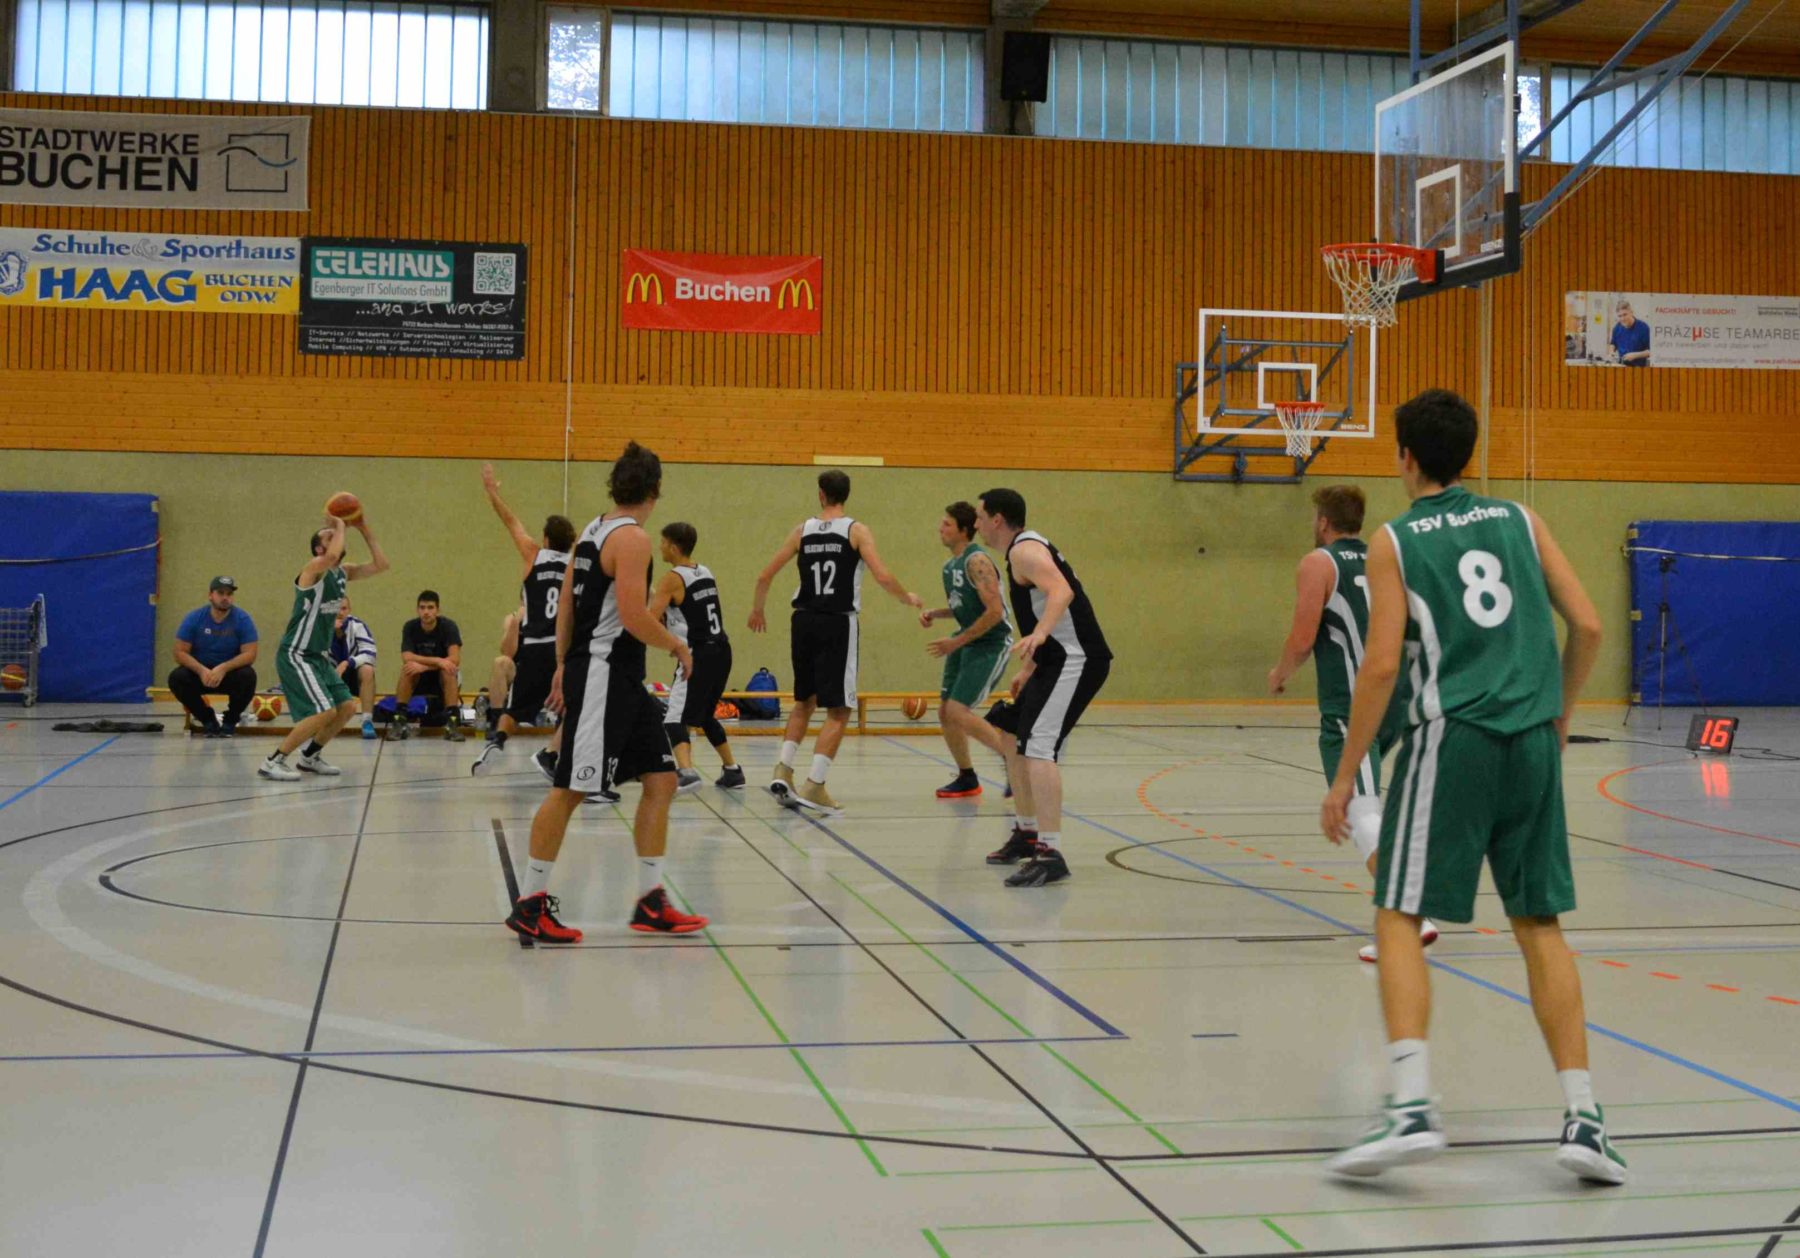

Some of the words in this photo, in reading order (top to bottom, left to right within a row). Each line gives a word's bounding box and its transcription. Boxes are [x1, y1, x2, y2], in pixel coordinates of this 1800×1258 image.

[0, 126, 200, 155] STADTWERKE
[0, 152, 199, 192] BUCHEN
[32, 234, 131, 256] Schuhe
[160, 238, 297, 262] Sporthaus
[315, 250, 450, 278] TELEHAUS
[39, 267, 197, 304] HAAG
[205, 274, 294, 288] BUCHEN
[314, 281, 365, 296] Egenberger
[367, 283, 377, 294] IT
[377, 284, 418, 297] Solutions
[419, 285, 448, 297] GmbH
[675, 278, 771, 303] Buchen
[1727, 327, 1800, 341] TEAMARBE
[1408, 514, 1442, 534] TSV
[1446, 505, 1510, 528] Buchen
[810, 560, 837, 595] 12
[952, 569, 965, 587] 15
[1458, 549, 1513, 628] 8
[545, 586, 560, 619] 8
[706, 603, 721, 635] 5
[1700, 719, 1732, 749] 16
